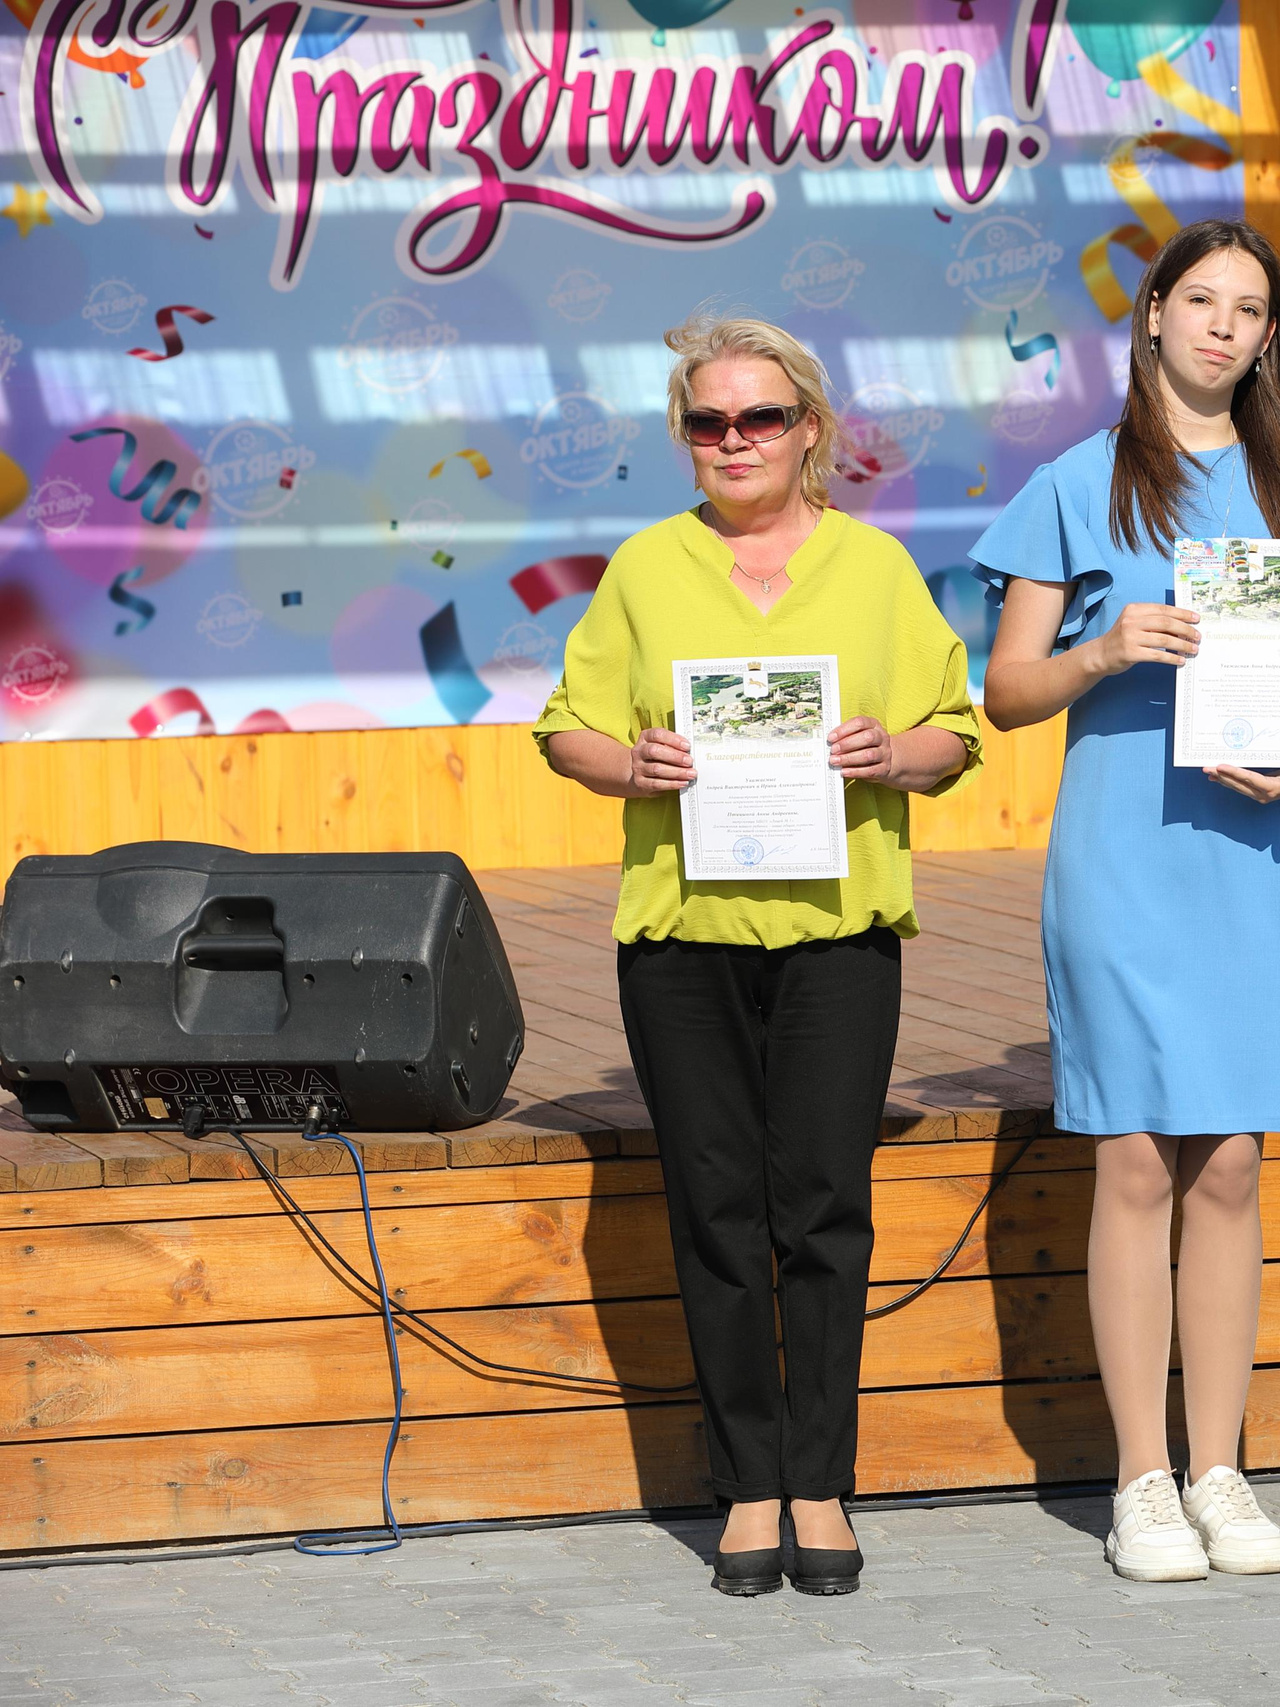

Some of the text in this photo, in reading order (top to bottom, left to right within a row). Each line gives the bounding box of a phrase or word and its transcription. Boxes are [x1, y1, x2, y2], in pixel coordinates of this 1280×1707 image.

[781, 258, 865, 291] ОКТЯБРЬ
[945, 240, 1065, 287] ОКТЯБРЬ
[82, 293, 148, 319] ОКТЯБРЬ
[519, 417, 641, 463] ОКТЯБРЬ
[192, 445, 316, 493] ОКТЯБРЬ
[26, 493, 94, 519] ОКТЯБРЬ
[1, 660, 69, 689] ОКТЯБРЬ
[705, 749, 814, 762] Благодарственное письмо
[147, 1067, 341, 1095] OPERA
